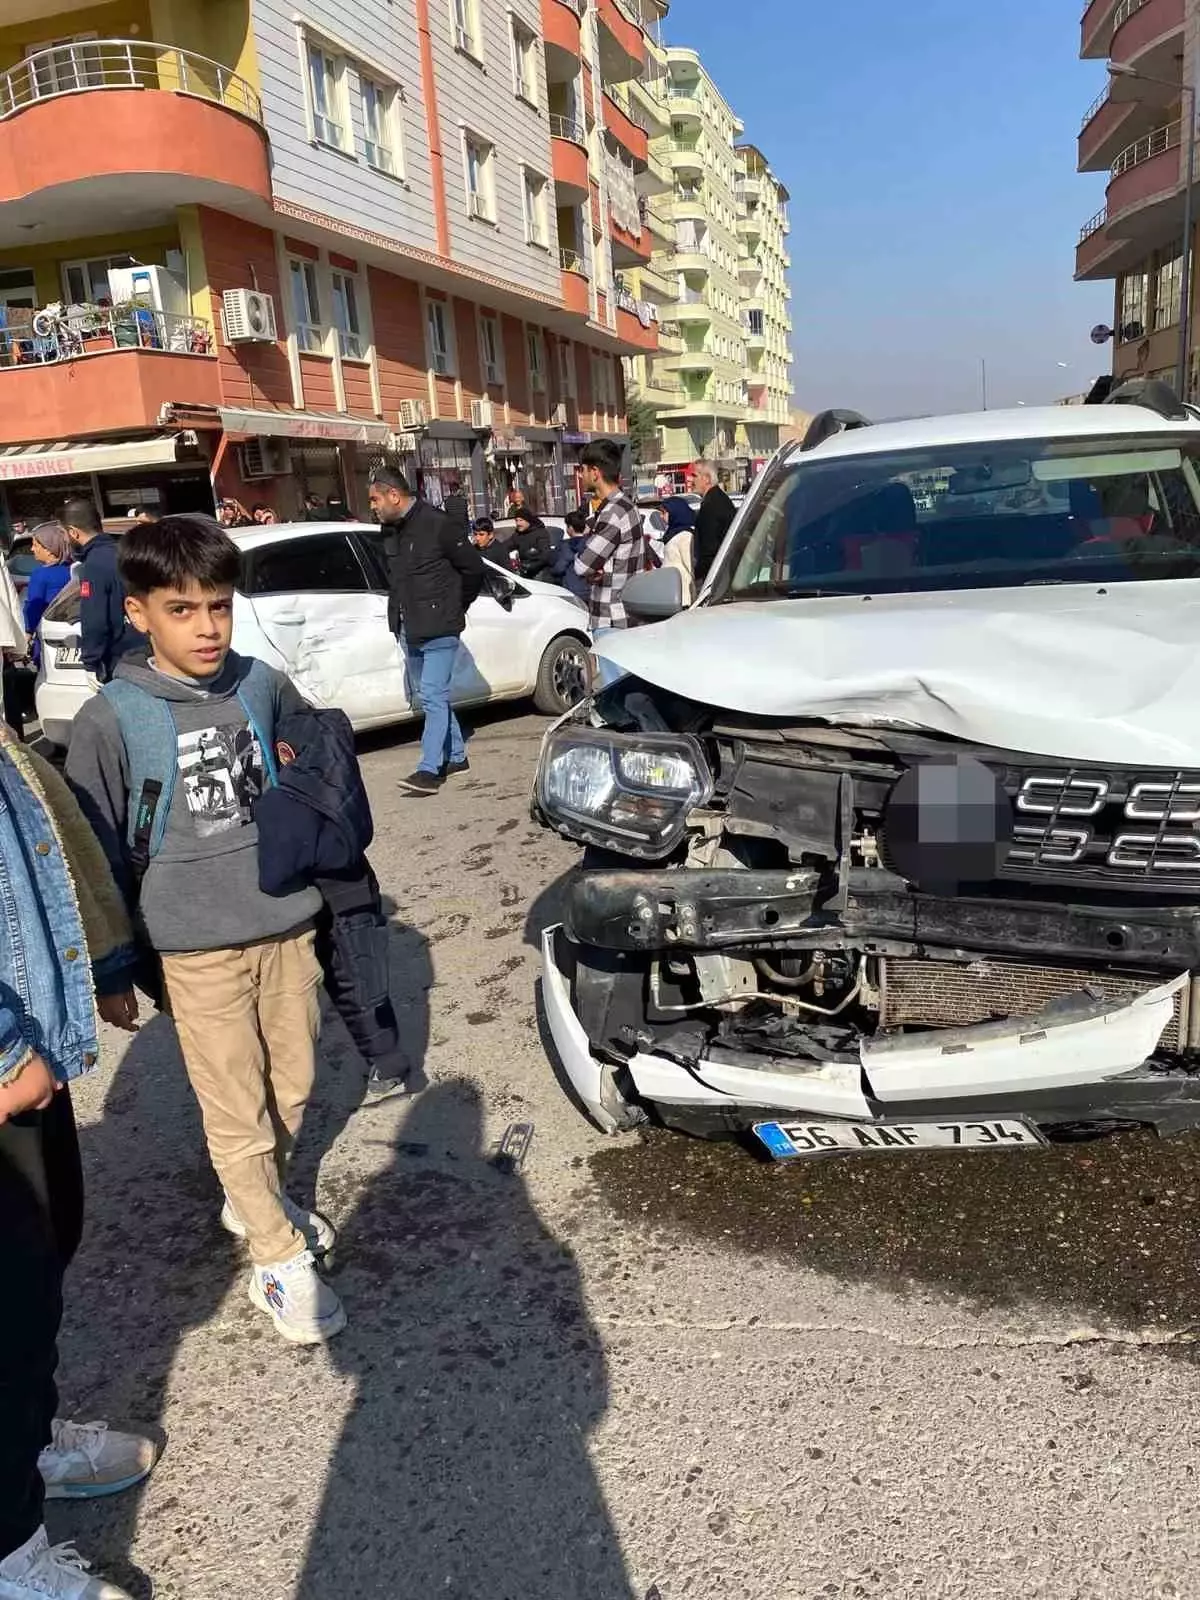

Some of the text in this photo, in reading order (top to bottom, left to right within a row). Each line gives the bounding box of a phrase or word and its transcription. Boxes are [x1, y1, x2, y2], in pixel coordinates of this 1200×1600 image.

[12, 457, 74, 477] MARKET
[783, 1126, 838, 1149] 56
[851, 1126, 919, 1146] AAF
[936, 1123, 1024, 1144] 734
